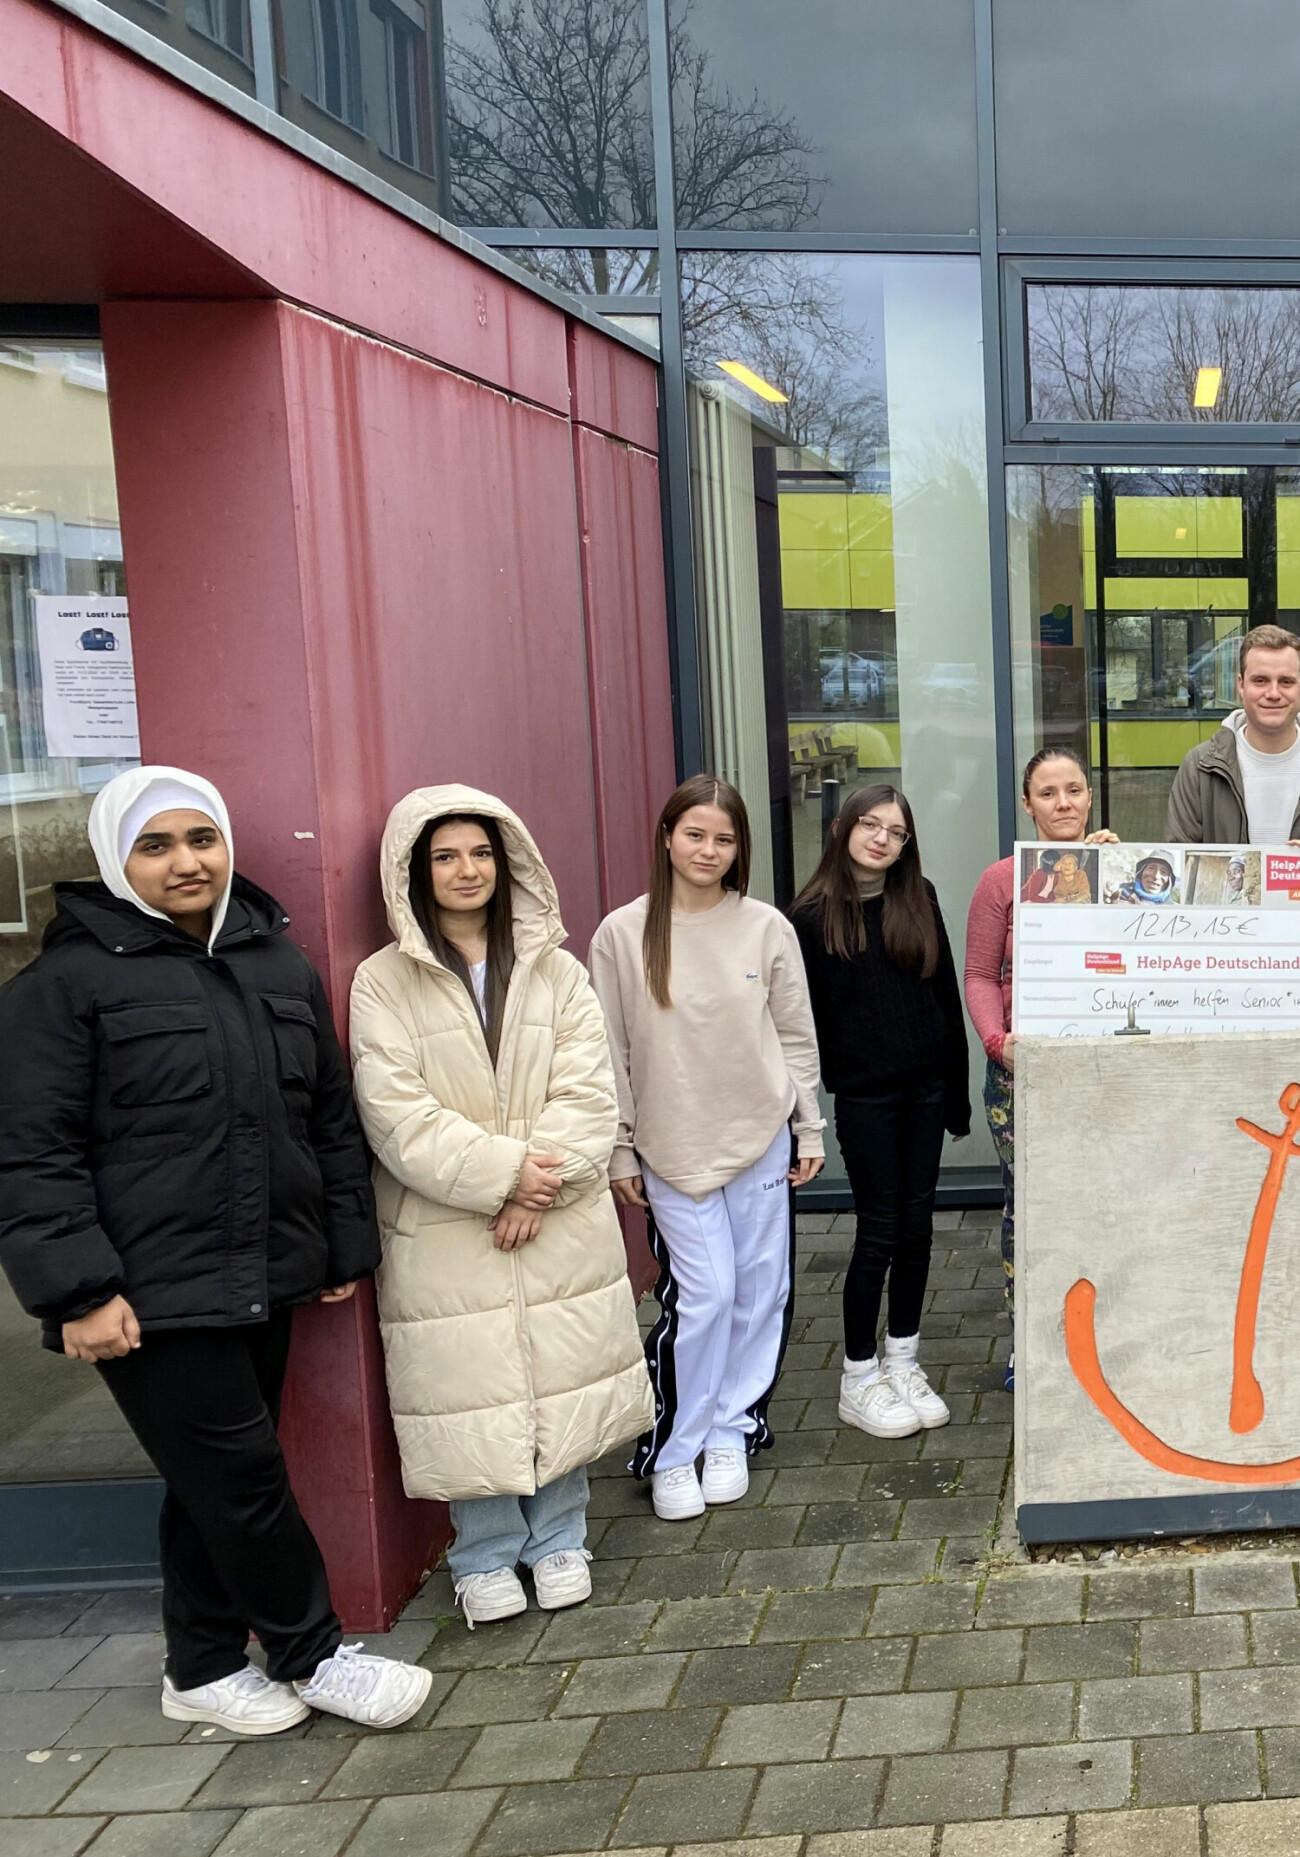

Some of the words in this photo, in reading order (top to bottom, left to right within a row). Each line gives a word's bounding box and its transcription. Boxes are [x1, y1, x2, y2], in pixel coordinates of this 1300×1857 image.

[1137, 956, 1201, 971] HelpAge
[1205, 956, 1300, 970] Deutschland
[1193, 988, 1230, 1017] helfen
